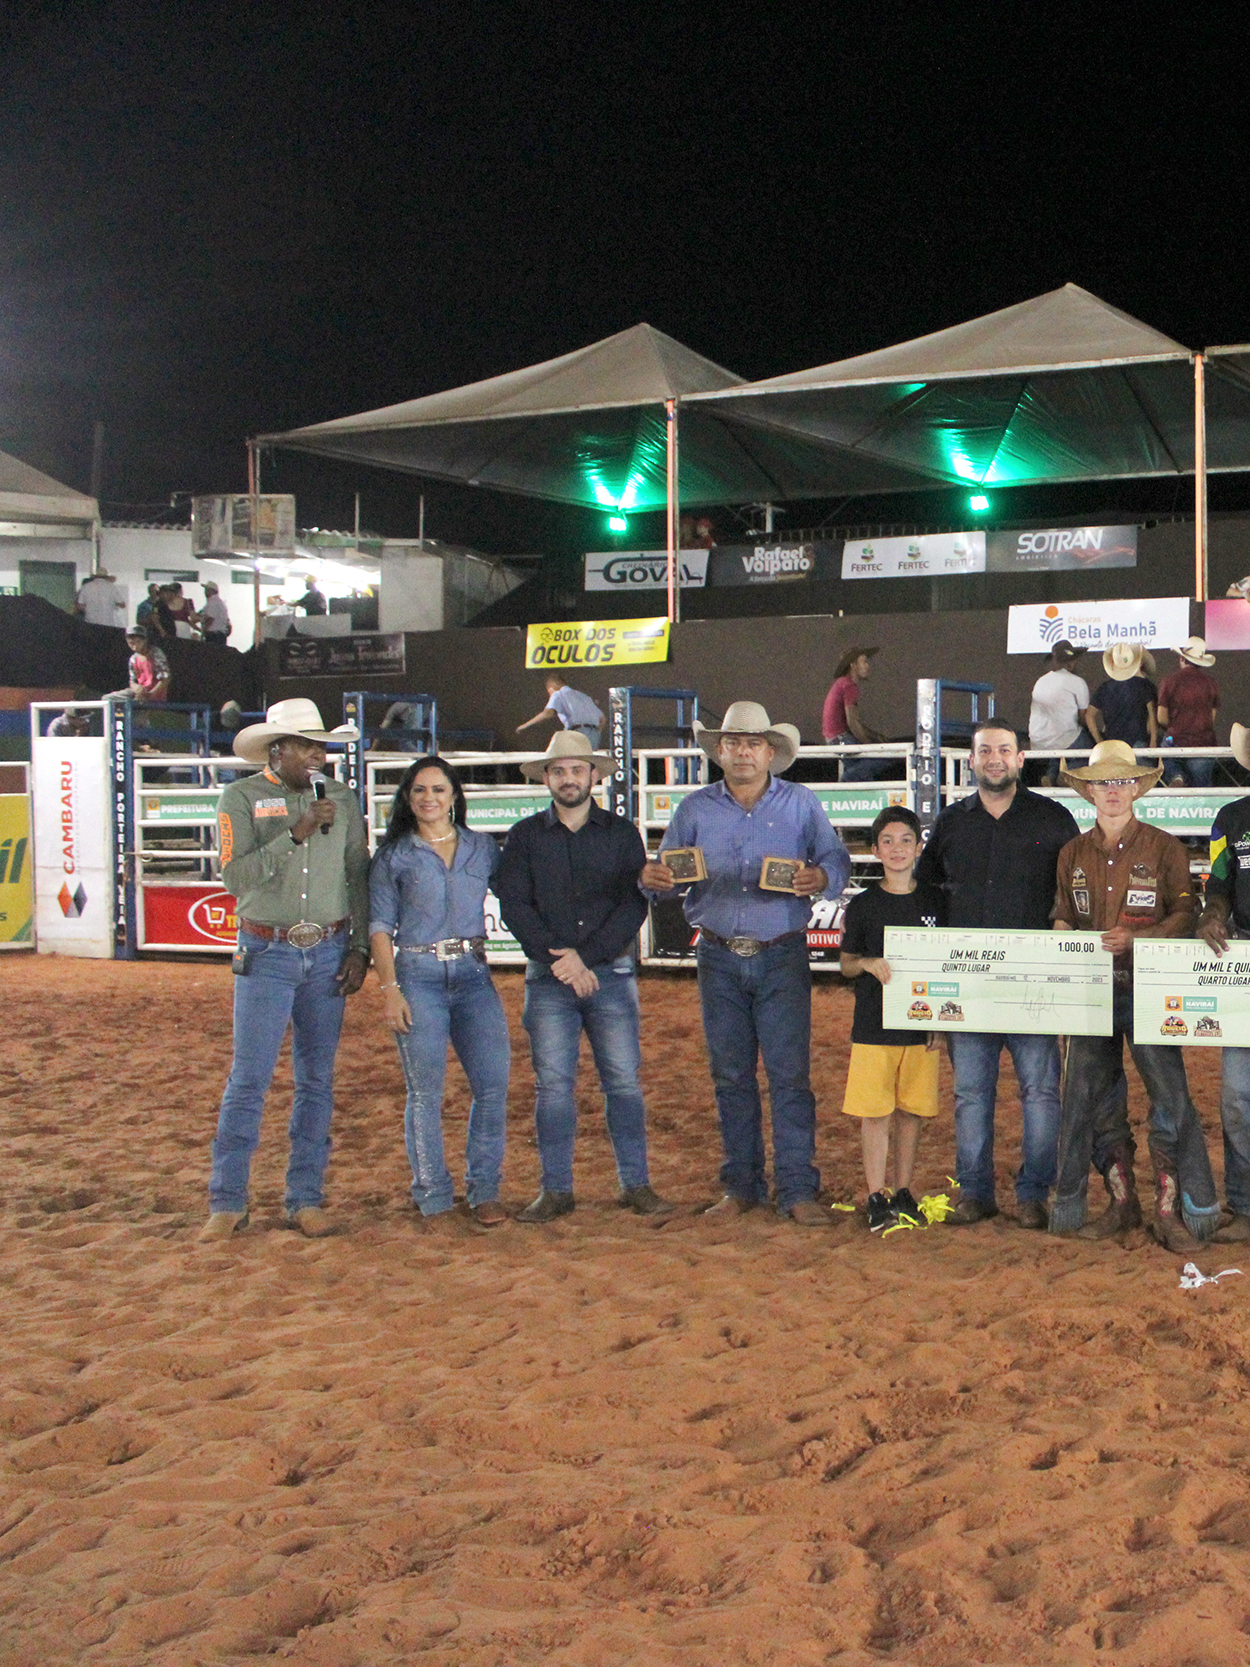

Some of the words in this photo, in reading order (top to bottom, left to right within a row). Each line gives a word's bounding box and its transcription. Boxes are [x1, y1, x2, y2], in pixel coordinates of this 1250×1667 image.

[1017, 531, 1102, 553] SOTRAN
[754, 546, 804, 561] Rafael
[742, 556, 810, 575] Volpato
[851, 562, 882, 572] FERTEC
[898, 560, 930, 570] FERTEC
[554, 629, 582, 641] BOX
[586, 628, 616, 641] DOS
[1068, 625, 1101, 639] Bela
[1107, 621, 1156, 637] Manhã
[531, 643, 616, 664] ÓCULOS
[116, 720, 124, 782] RANCHO
[161, 803, 215, 815] PREFEITURA
[831, 797, 883, 811] NAVIRAÍ
[61, 760, 75, 875] CAMBARU
[521, 807, 535, 817] DE
[1150, 808, 1165, 818] DE
[1169, 808, 1219, 818] NAVIRA
[117, 793, 125, 874] PORTEIRA
[950, 949, 963, 960] UM
[965, 950, 979, 960] MIL
[981, 950, 1005, 961] REAIS
[942, 963, 967, 972] QUINTO
[967, 963, 991, 973] LUGAR
[1193, 961, 1207, 972] UM
[1209, 962, 1224, 973] MIL
[1227, 962, 1233, 973] E
[1198, 976, 1227, 986] QUARTO
